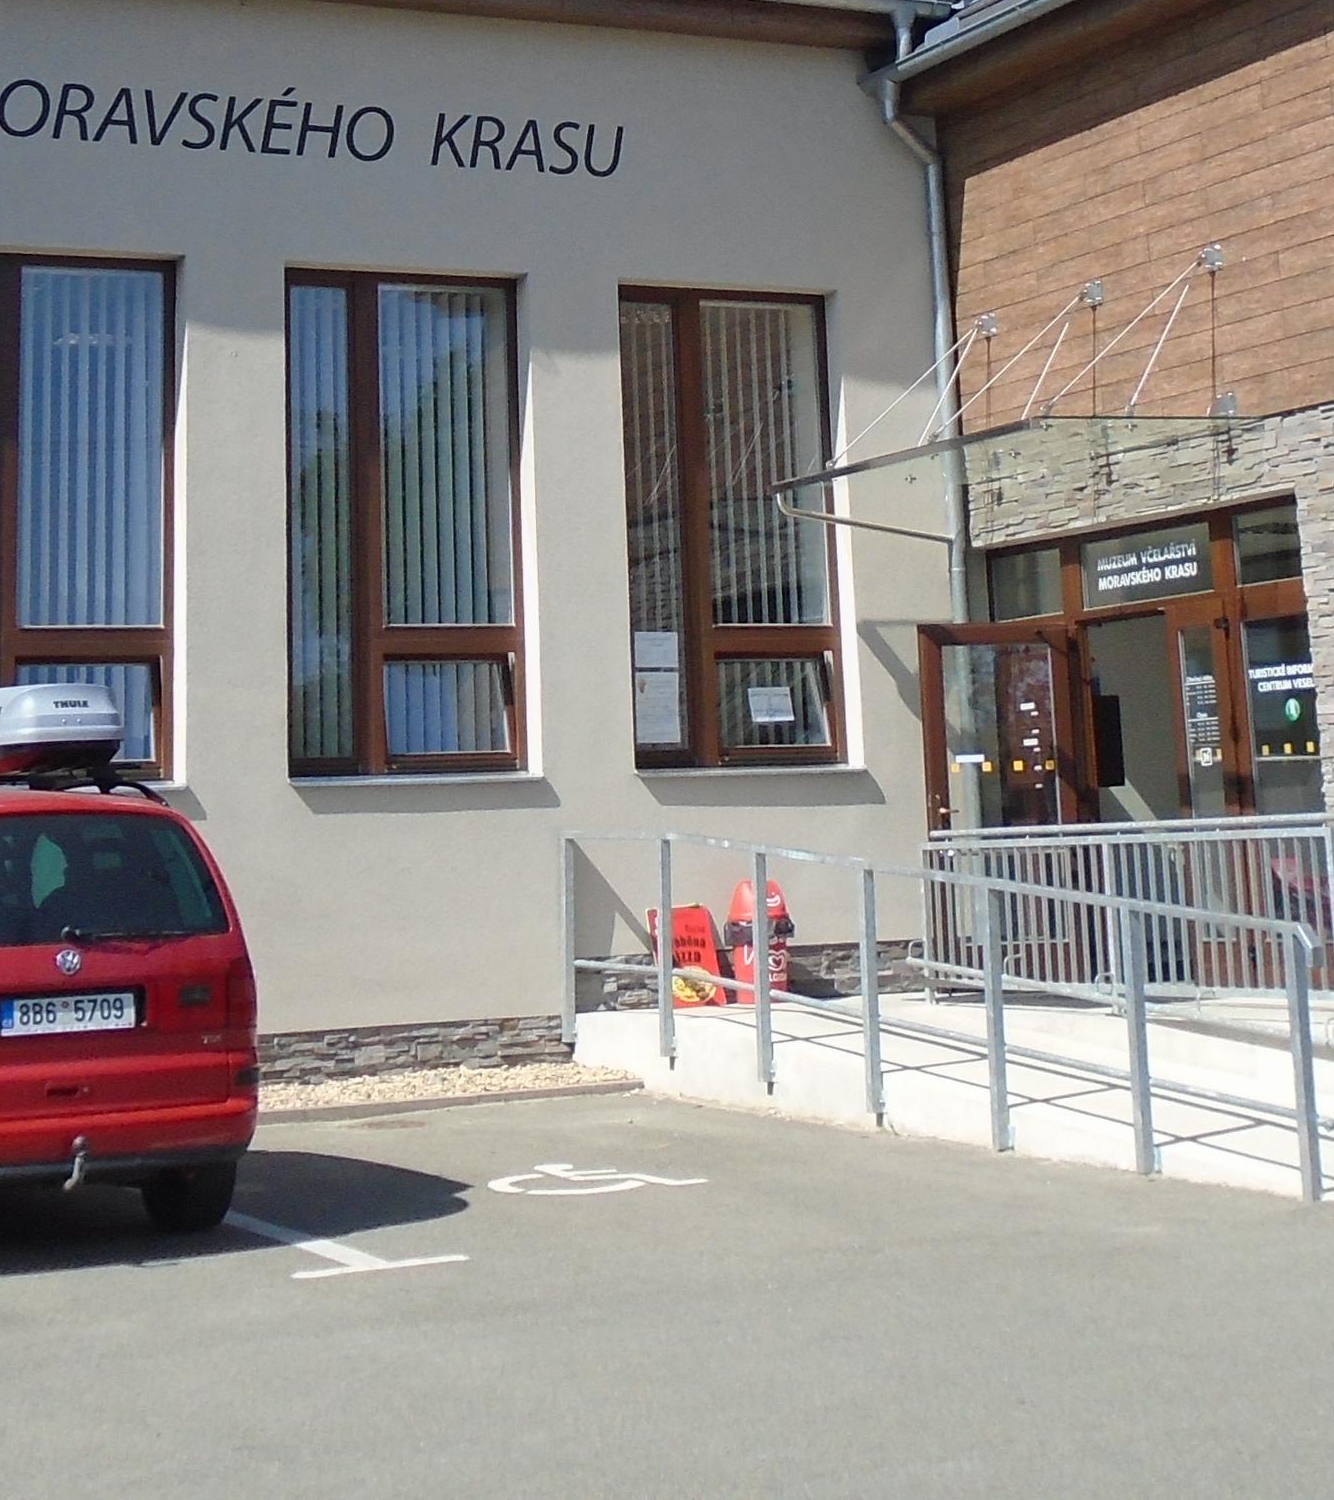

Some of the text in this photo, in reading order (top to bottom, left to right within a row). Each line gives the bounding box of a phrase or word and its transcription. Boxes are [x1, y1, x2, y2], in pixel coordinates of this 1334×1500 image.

[431, 113, 624, 177] KRASU
[1097, 538, 1197, 571] MUZEUM VČELAŘSTVÍ
[1098, 561, 1198, 591] MORAVSKÉHO KRASU
[1248, 663, 1286, 679] TURISTICKÉ
[1258, 679, 1293, 692] CENTRUM
[53, 700, 89, 709] THULE
[19, 998, 124, 1025] 8B6 5709
